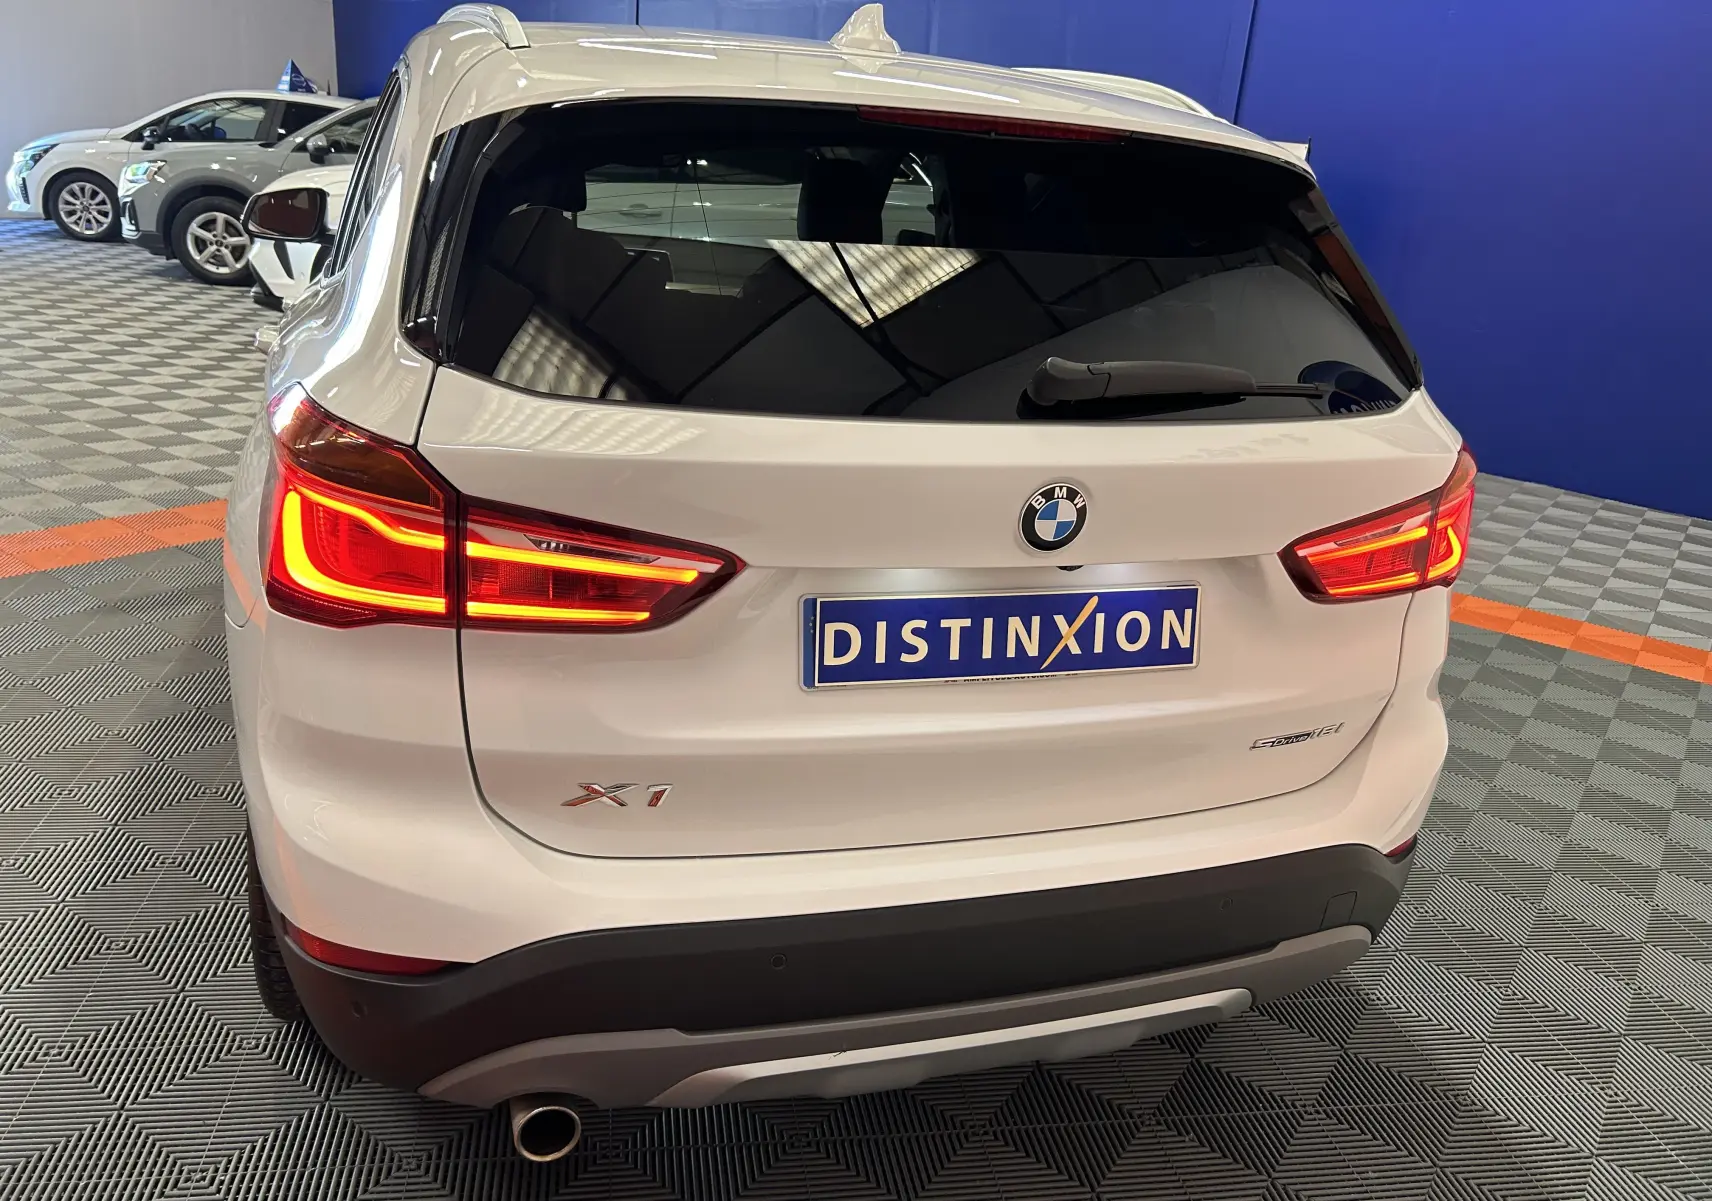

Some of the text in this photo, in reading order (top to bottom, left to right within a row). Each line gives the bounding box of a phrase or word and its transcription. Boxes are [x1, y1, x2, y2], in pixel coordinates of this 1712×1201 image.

[1031, 486, 1086, 510] BMW
[823, 596, 1194, 669] DISTINXION
[560, 782, 674, 808] X1
